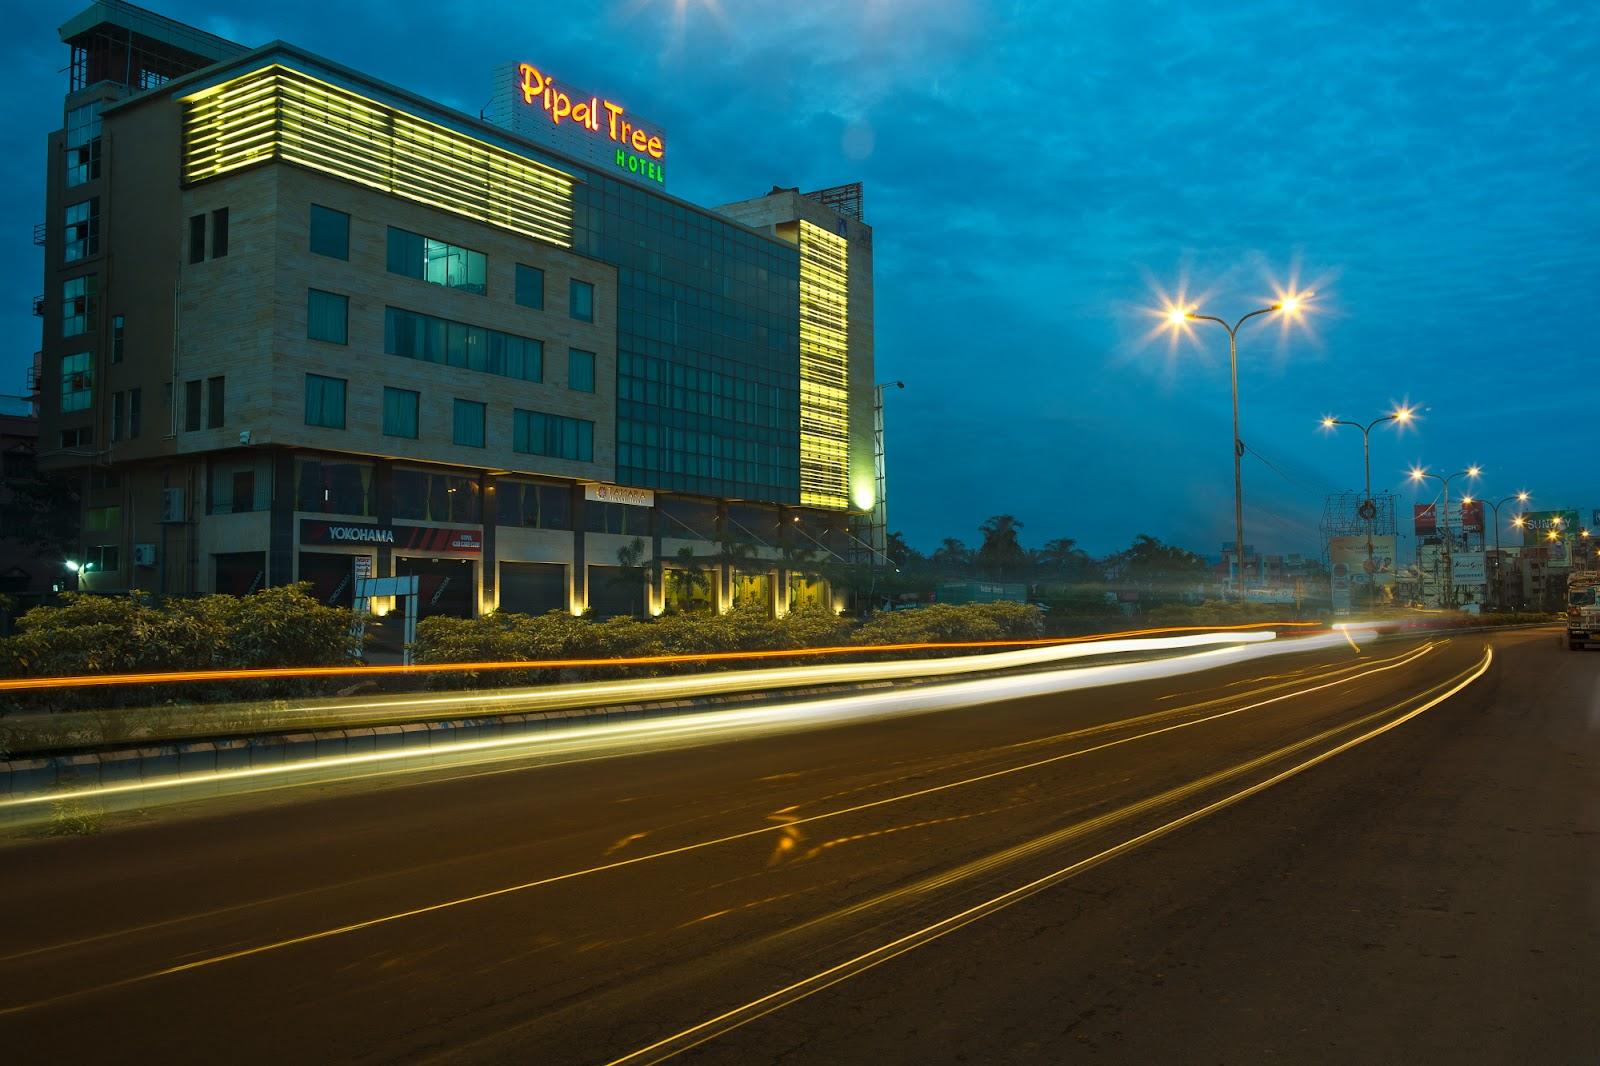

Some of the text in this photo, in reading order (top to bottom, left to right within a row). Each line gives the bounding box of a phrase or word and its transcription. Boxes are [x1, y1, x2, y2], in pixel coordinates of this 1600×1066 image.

[519, 63, 664, 159] Pipal Tree
[615, 148, 664, 183] HOTEL
[329, 526, 394, 543] YOKOHAMA
